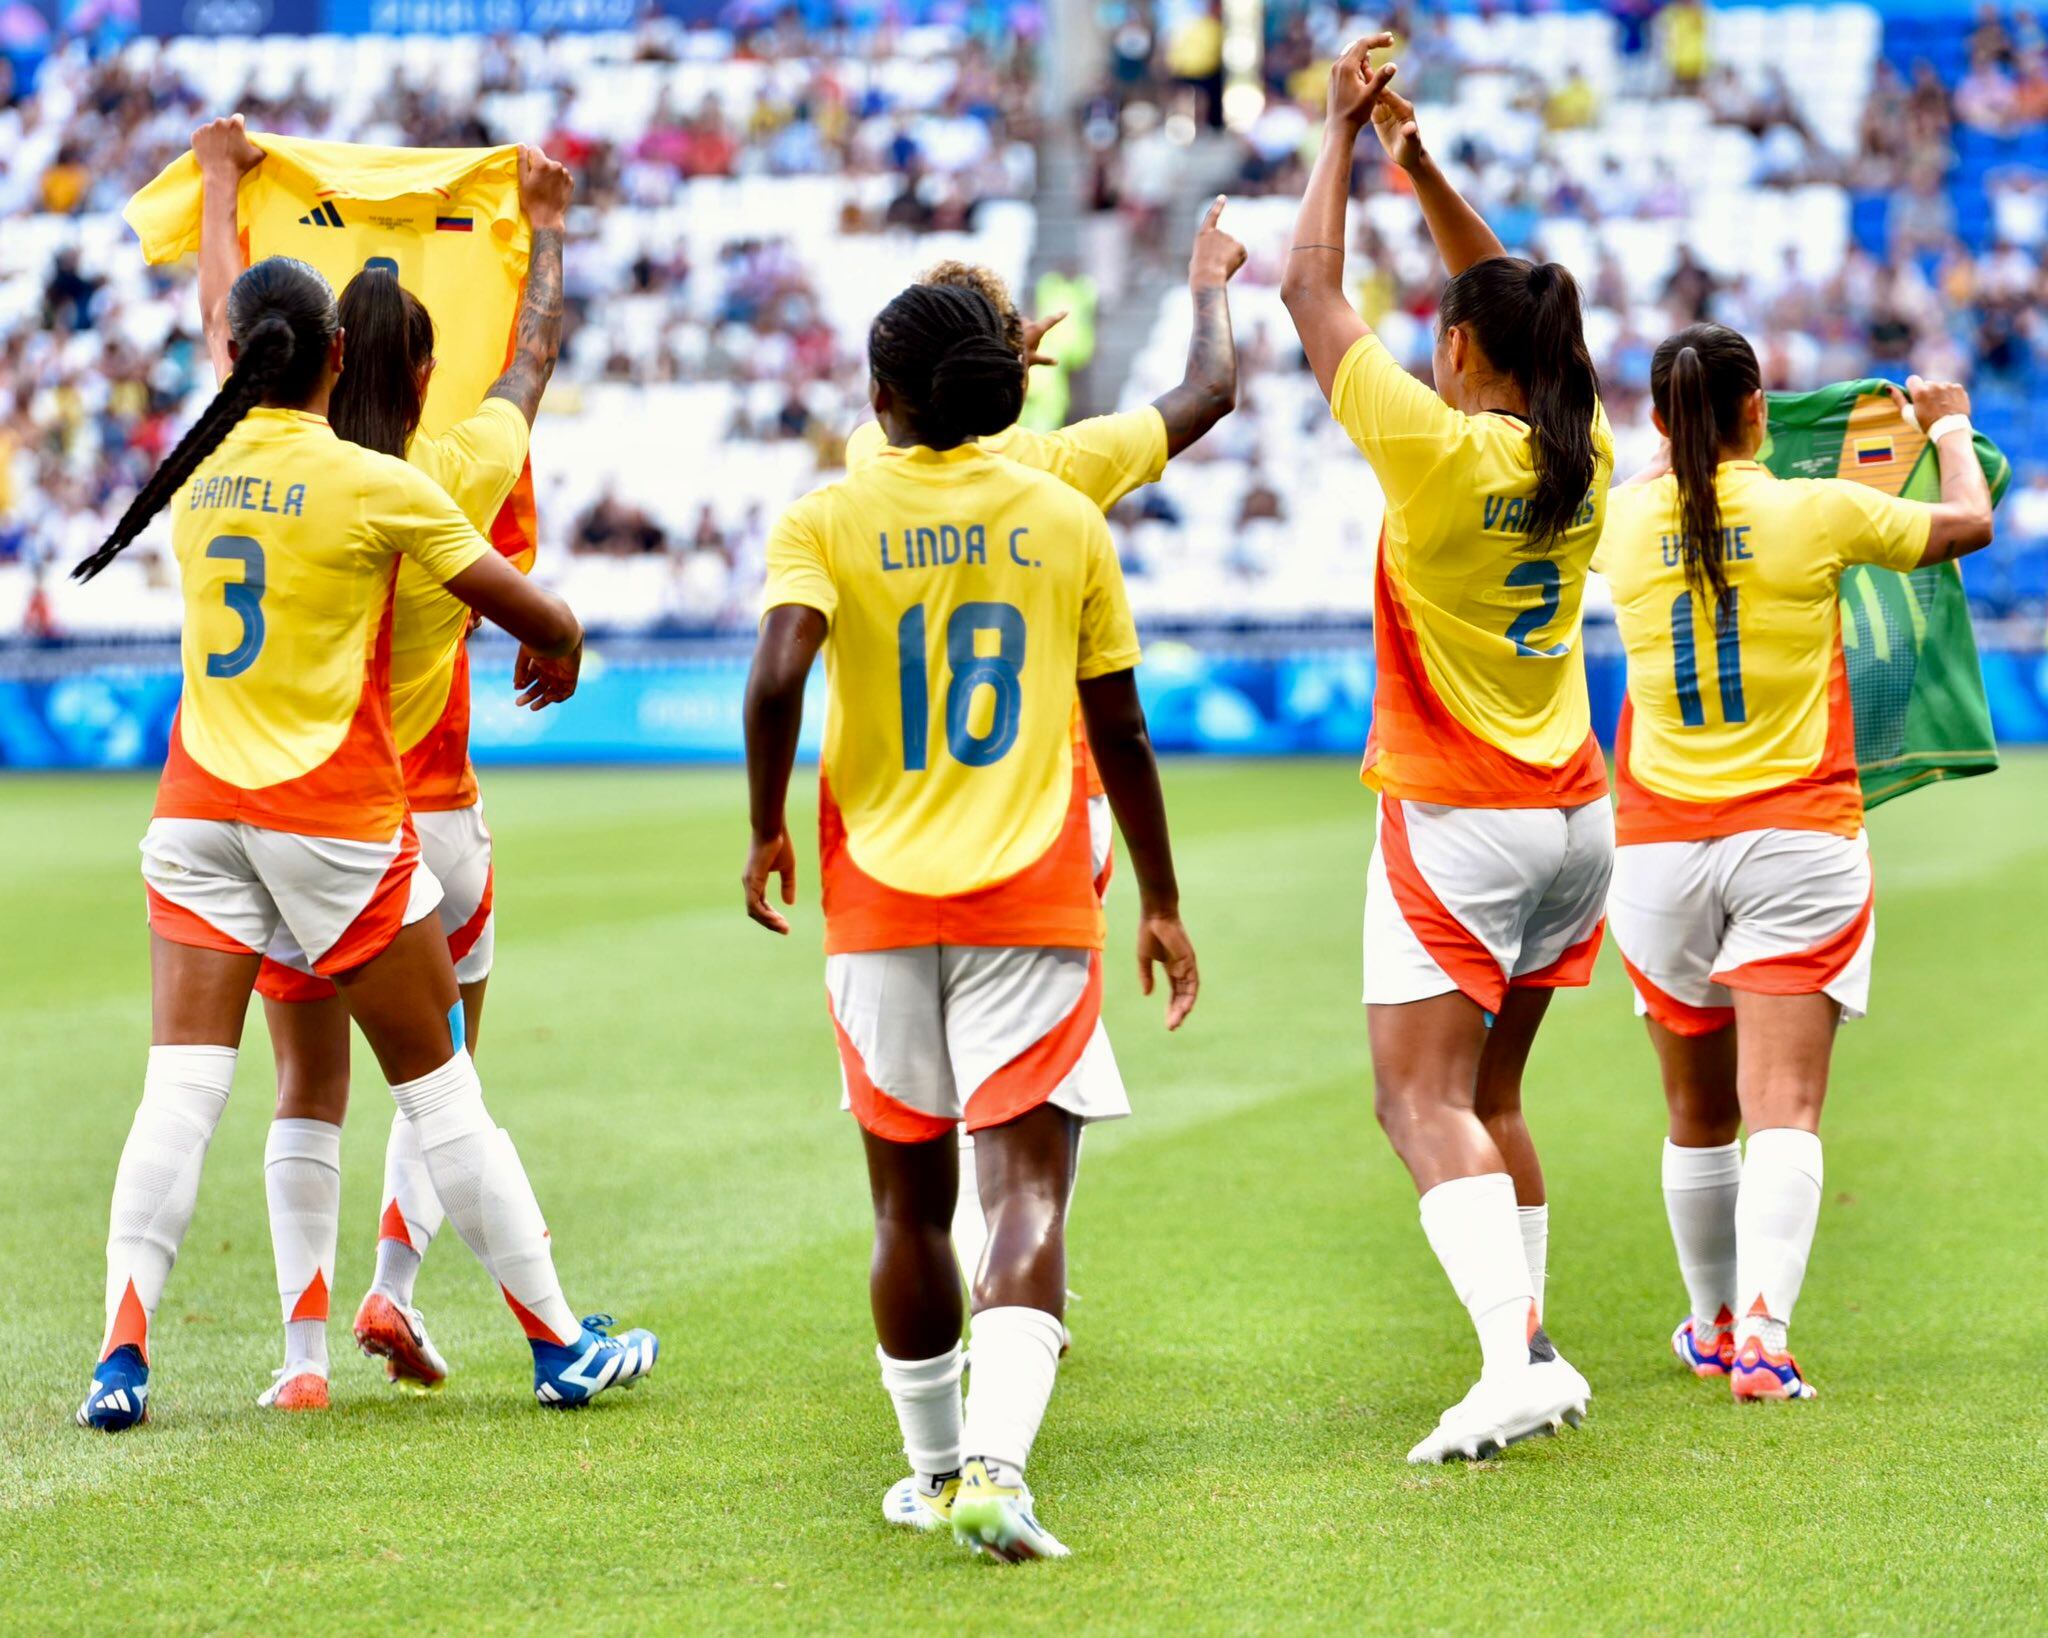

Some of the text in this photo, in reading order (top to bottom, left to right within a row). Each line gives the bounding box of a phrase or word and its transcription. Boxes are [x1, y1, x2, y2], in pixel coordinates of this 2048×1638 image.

[190, 475, 306, 517] DANIELA
[880, 524, 1042, 571] LINDA C.
[205, 534, 266, 679] 3
[1504, 559, 1571, 657] 2
[1671, 586, 1747, 726] 11
[898, 601, 1026, 771] 18
